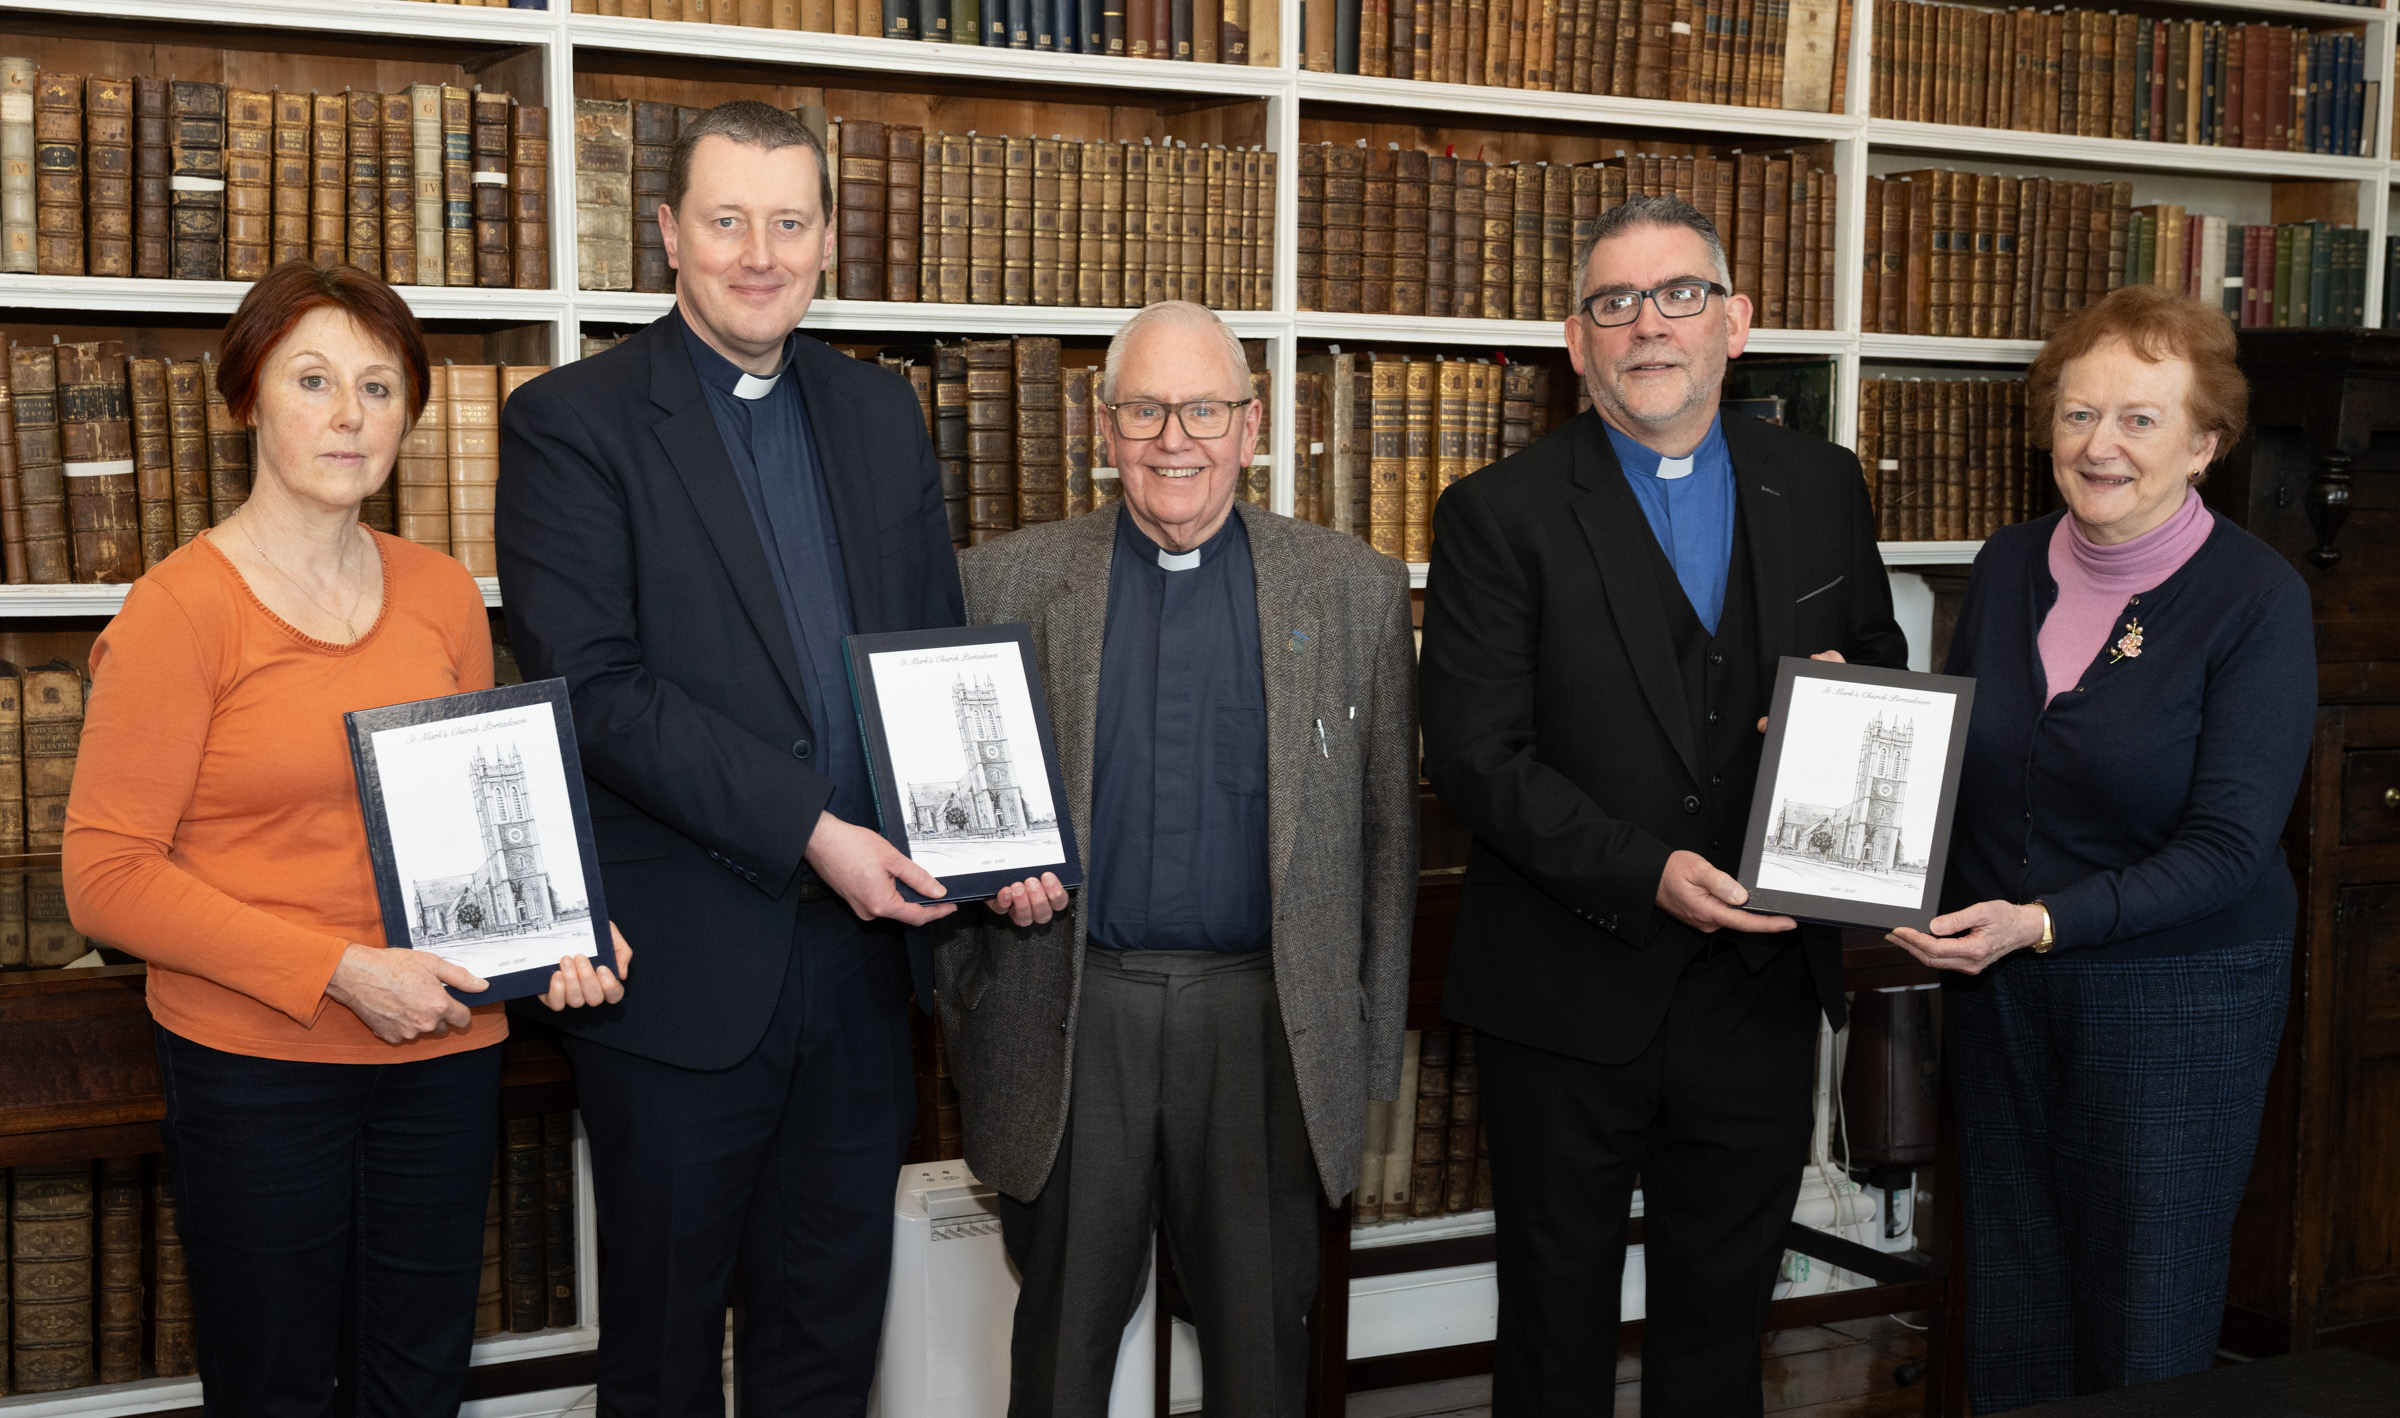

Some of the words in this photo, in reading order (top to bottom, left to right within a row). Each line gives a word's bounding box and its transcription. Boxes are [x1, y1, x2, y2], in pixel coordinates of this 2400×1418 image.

[423, 103, 434, 114] G
[423, 182, 439, 193] IV
[427, 258, 438, 268] 18
[898, 658, 907, 666] St
[908, 656, 934, 666] Mark's
[936, 654, 959, 664] Church
[960, 652, 999, 662] Portadown
[1820, 686, 1830, 694] St
[1832, 687, 1860, 698] Mark's
[1861, 690, 1888, 700] Church
[1888, 694, 1932, 706] Portadown
[405, 734, 416, 744] St
[418, 730, 448, 742] Mark's
[451, 724, 480, 736] Church
[481, 718, 528, 732] Portadown
